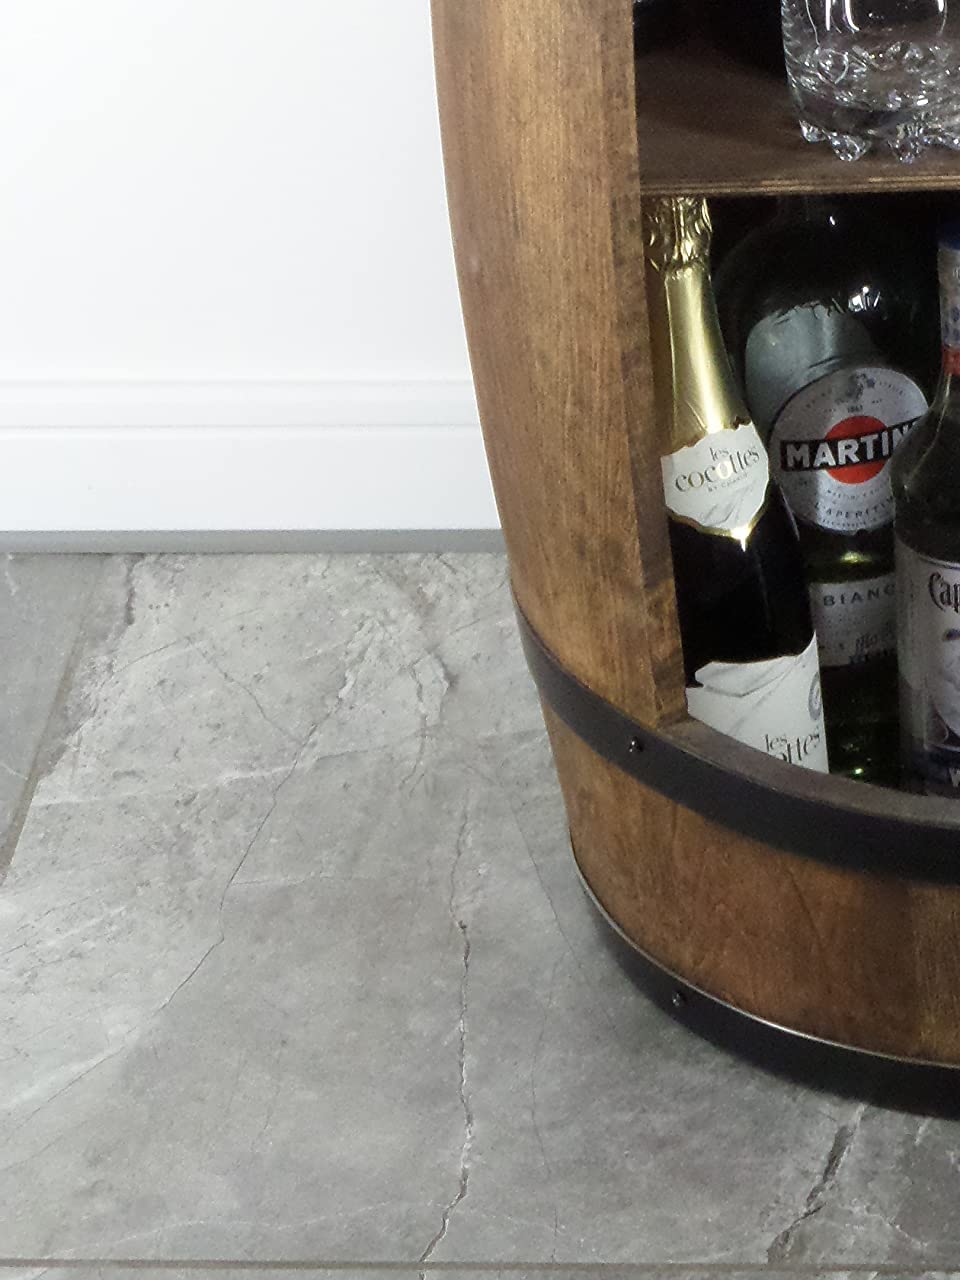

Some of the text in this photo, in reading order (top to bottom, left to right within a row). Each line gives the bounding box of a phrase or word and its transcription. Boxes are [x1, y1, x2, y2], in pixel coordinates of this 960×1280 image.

[709, 446, 730, 462] les
[784, 421, 916, 469] MARTIN
[822, 583, 897, 607] BIANC
